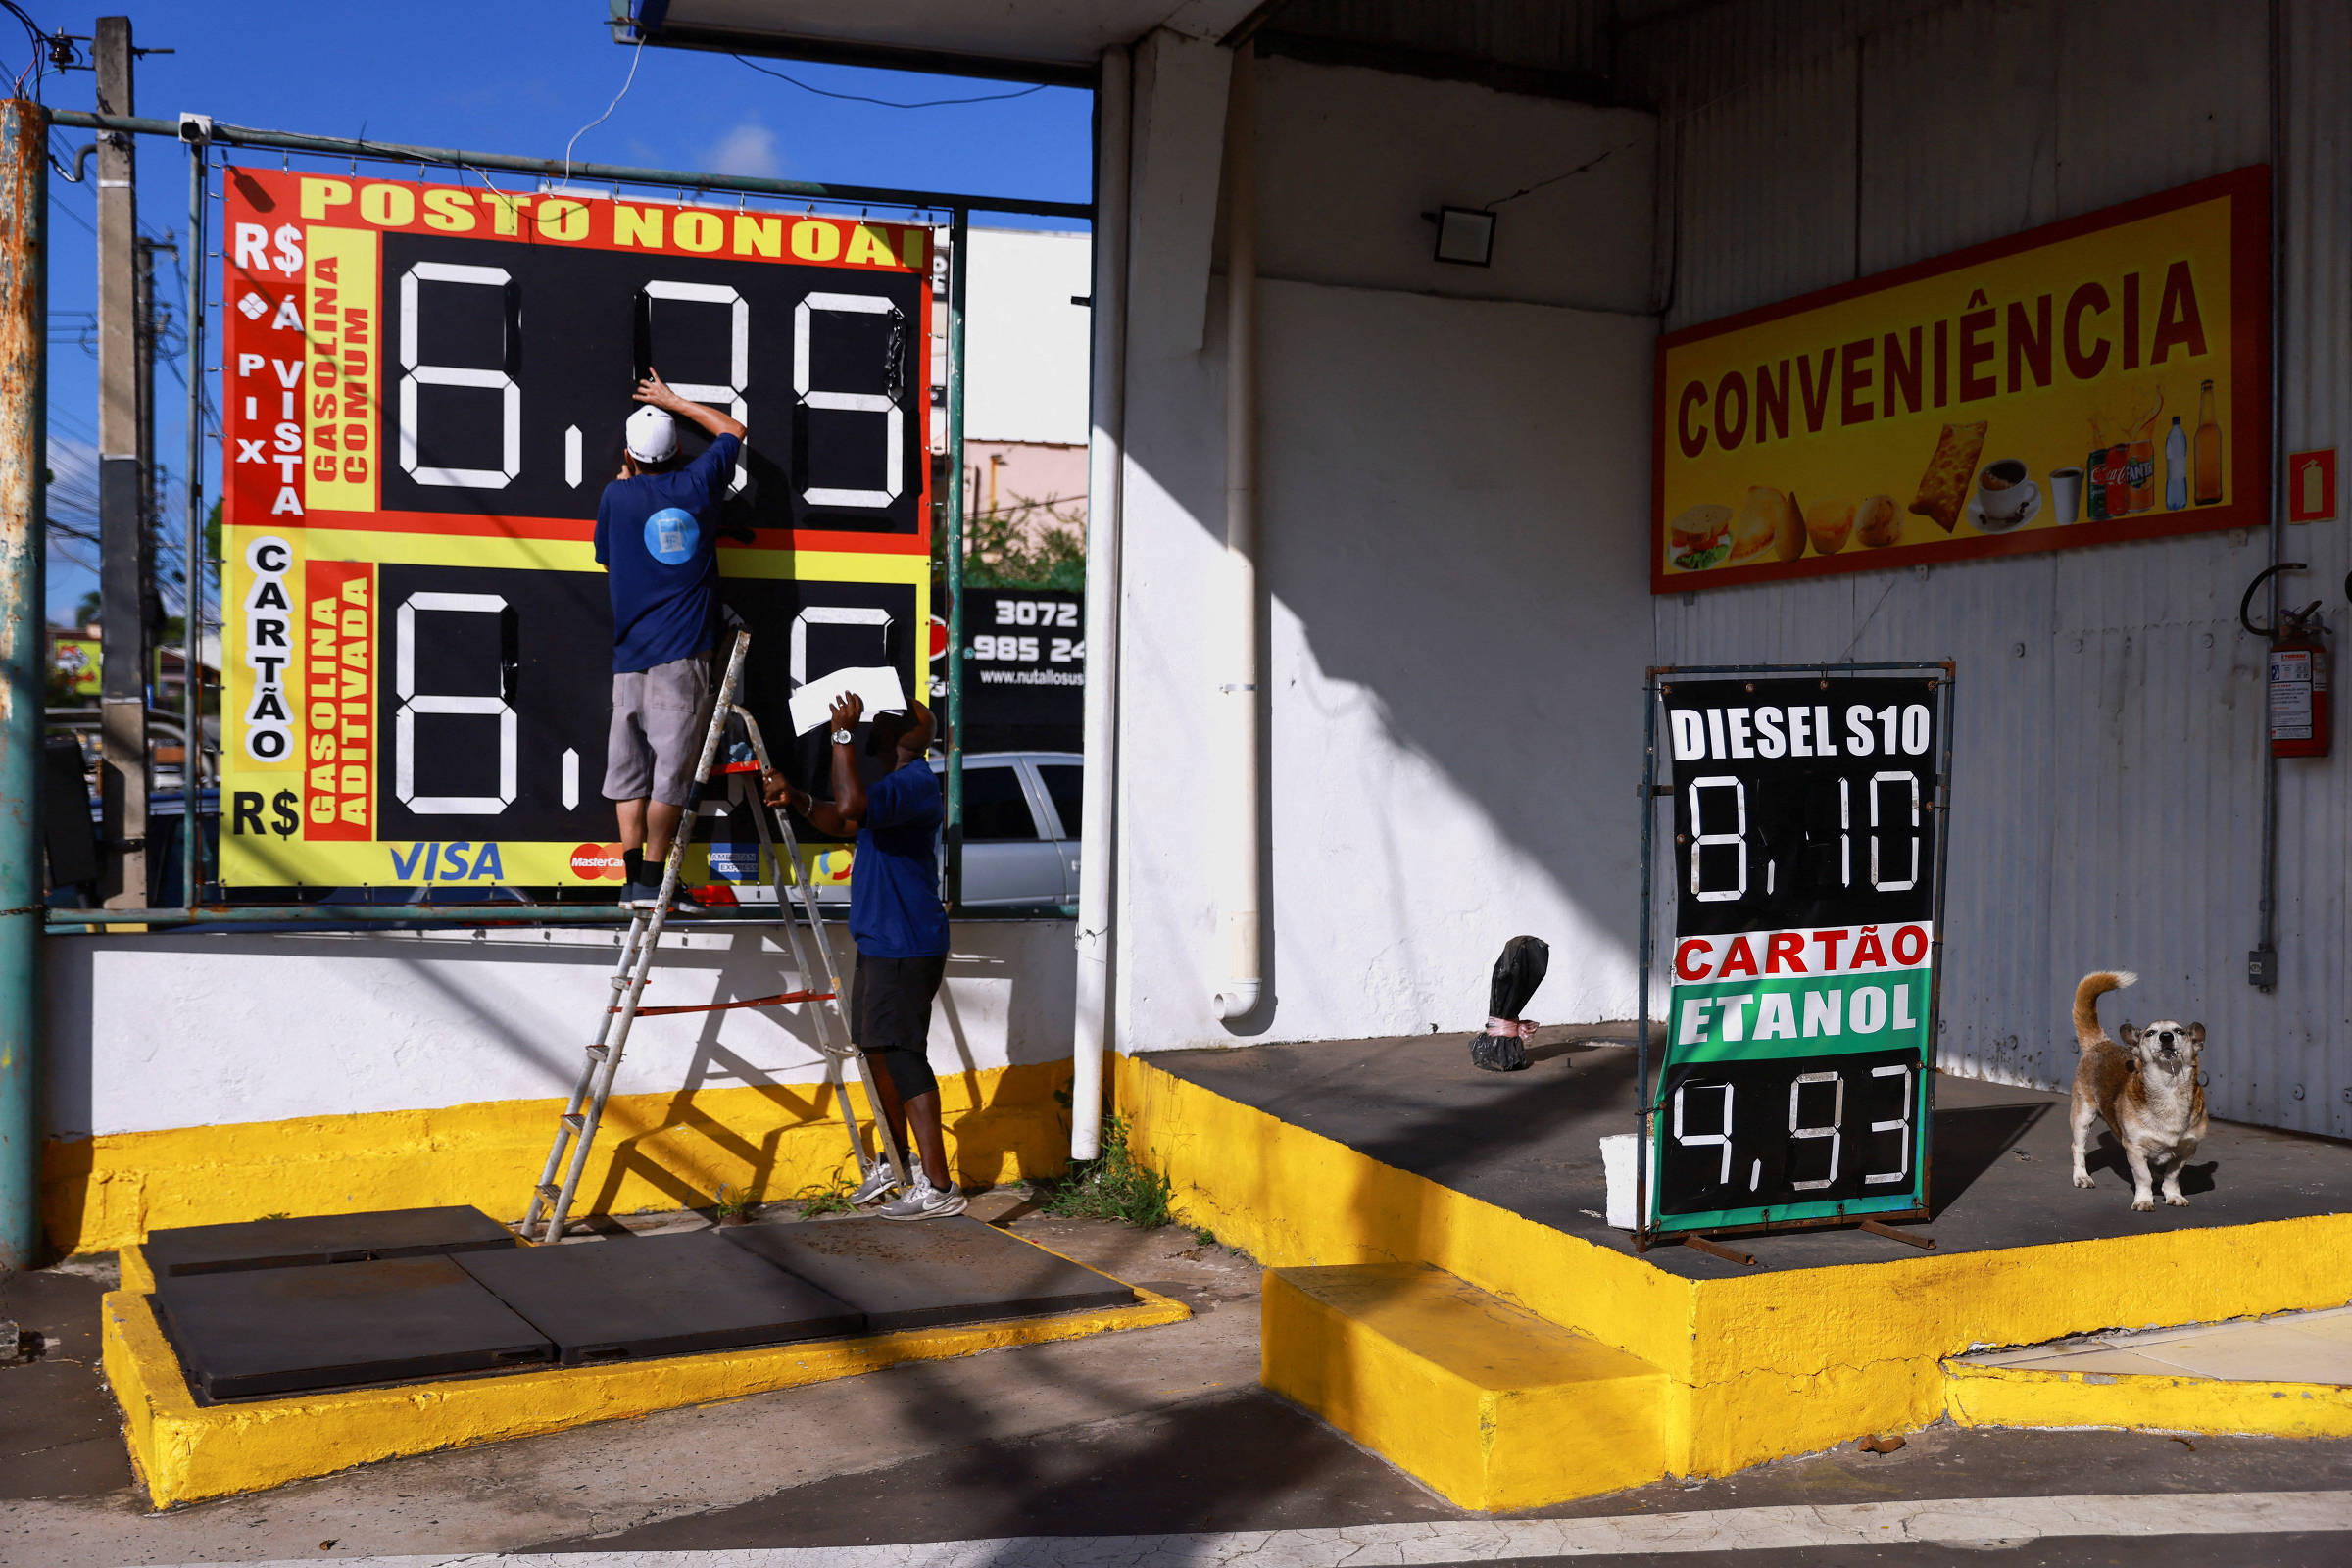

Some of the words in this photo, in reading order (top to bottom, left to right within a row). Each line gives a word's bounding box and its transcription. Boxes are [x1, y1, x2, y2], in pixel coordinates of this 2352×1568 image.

[235, 222, 304, 277] R$
[300, 177, 589, 242] POSTO
[614, 206, 924, 268] NONOAI
[314, 256, 338, 482] GASOLINA
[344, 308, 368, 483] COMUM
[1678, 259, 2209, 458] CONVENIÊNCIA
[236, 353, 267, 465] PIX
[271, 359, 305, 515] VISTA
[252, 545, 288, 758] CARTÃO
[974, 635, 1039, 662] 985
[995, 600, 1078, 627] 3072
[310, 597, 337, 824] GASOLINA
[341, 577, 368, 826] ADITIVADA
[1670, 706, 1837, 760] DIESEL
[1845, 704, 1930, 757] S10
[233, 789, 300, 841] R$
[390, 842, 504, 881] VISA
[571, 857, 625, 867] MasterCar
[1675, 925, 1929, 982] CARTÃO
[1678, 984, 1916, 1045] ETANOL
